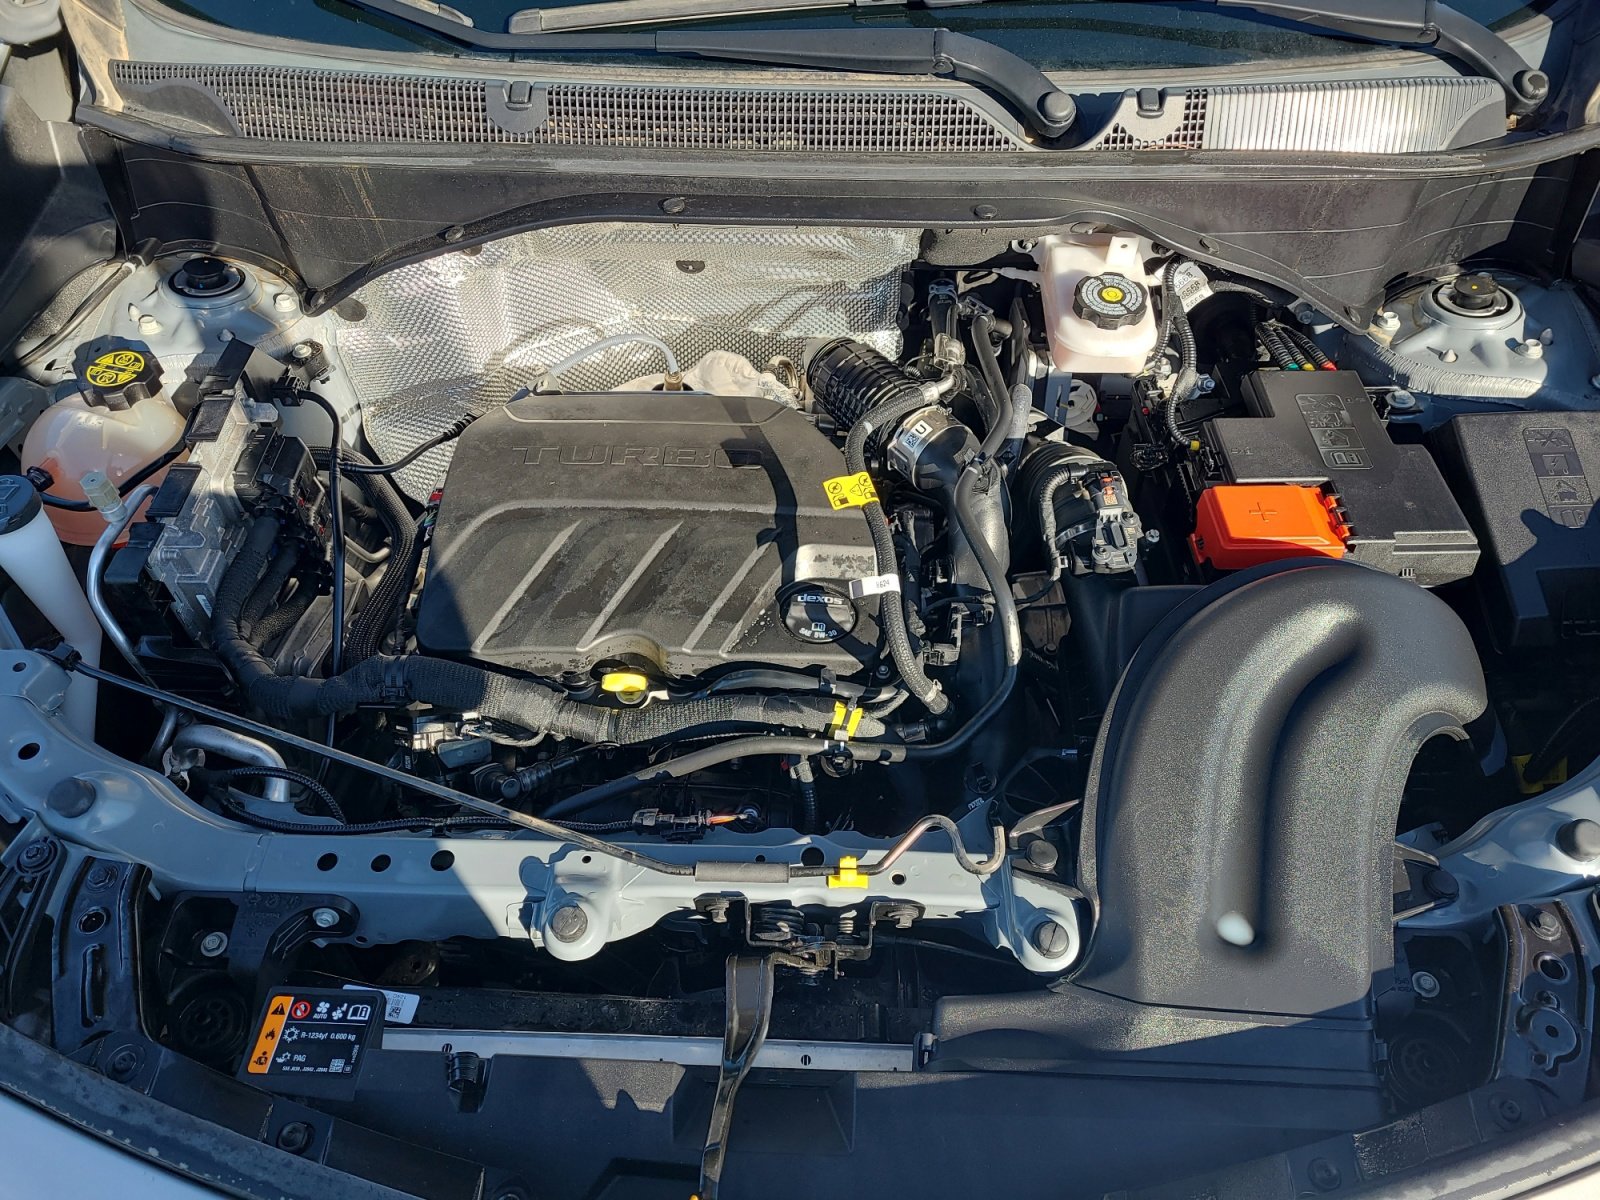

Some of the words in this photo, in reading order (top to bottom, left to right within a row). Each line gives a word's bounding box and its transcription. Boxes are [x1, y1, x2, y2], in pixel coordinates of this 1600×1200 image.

[512, 444, 763, 470] TURBO
[797, 594, 844, 605] dexos
[799, 627, 812, 637] SAE
[300, 1031, 328, 1041] R-1234yf
[348, 1033, 356, 1042] kg
[293, 1054, 306, 1062] PAG
